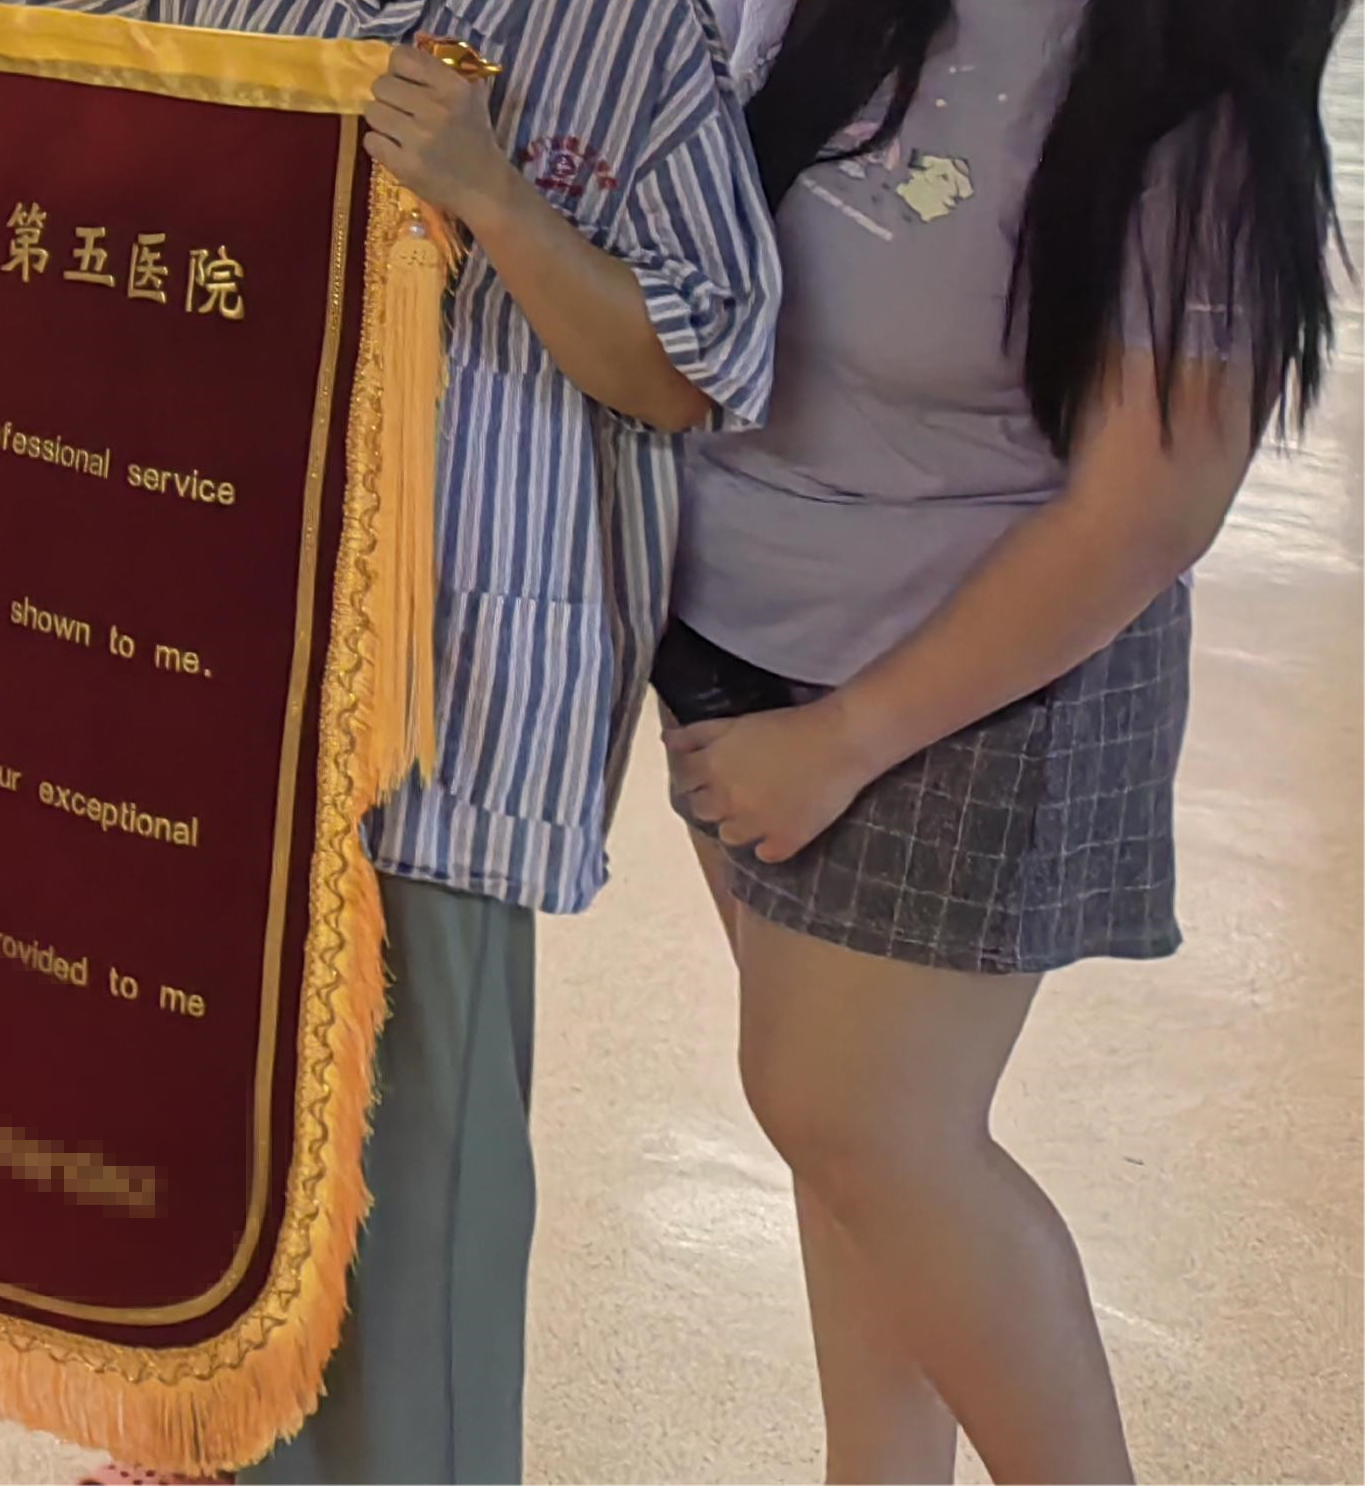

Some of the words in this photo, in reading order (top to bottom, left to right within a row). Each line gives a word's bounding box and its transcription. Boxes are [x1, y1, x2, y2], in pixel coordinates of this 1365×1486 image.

[126, 462, 236, 506] service
[9, 595, 92, 648] shown
[108, 624, 136, 660] to
[153, 643, 213, 679] me.
[37, 780, 200, 848] exceptional
[108, 965, 140, 1001] to
[158, 984, 206, 1018] me
